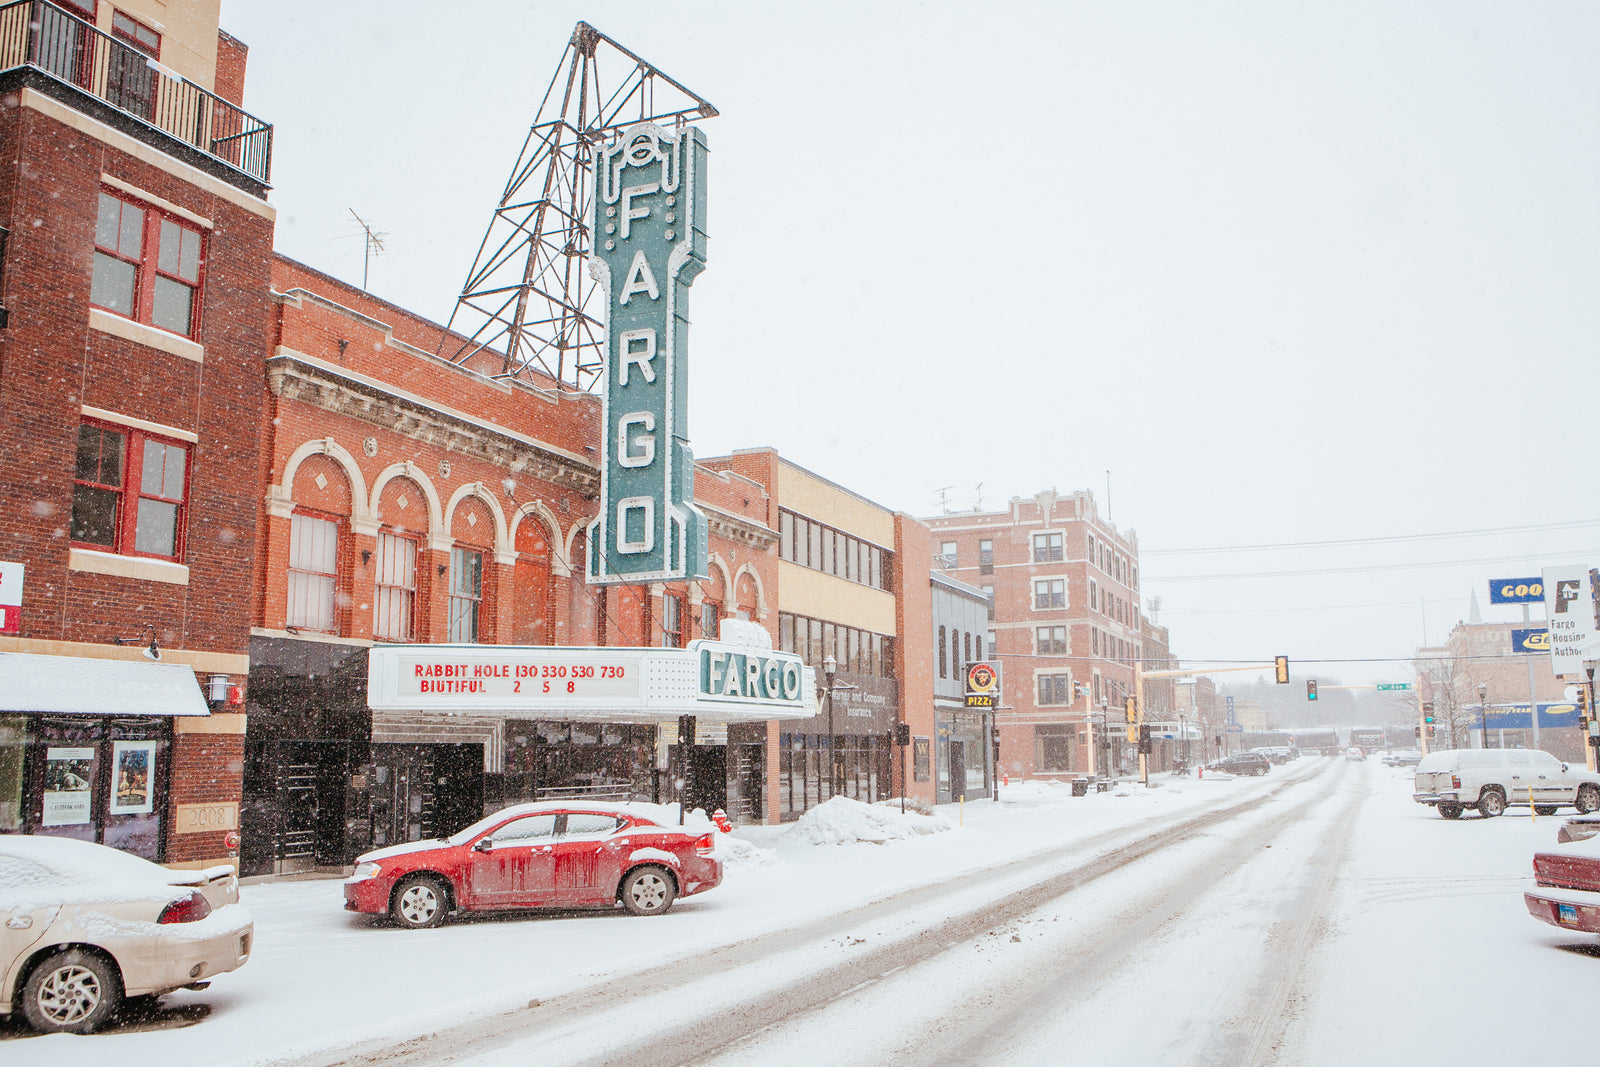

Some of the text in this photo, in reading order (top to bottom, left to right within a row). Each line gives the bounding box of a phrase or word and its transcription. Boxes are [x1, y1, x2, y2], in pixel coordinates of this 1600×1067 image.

[616, 182, 661, 554] FARGO
[1501, 584, 1545, 598] GOO
[1551, 619, 1575, 630] Fargo
[415, 664, 468, 677] RABBIT
[474, 665, 510, 677] HOLE
[541, 666, 567, 678] 330
[571, 666, 595, 678] 530
[600, 666, 625, 678] 730
[709, 651, 800, 700] FARGO
[420, 680, 575, 693] BIUTIFUL 2 5 8
[189, 807, 225, 826] 2008
